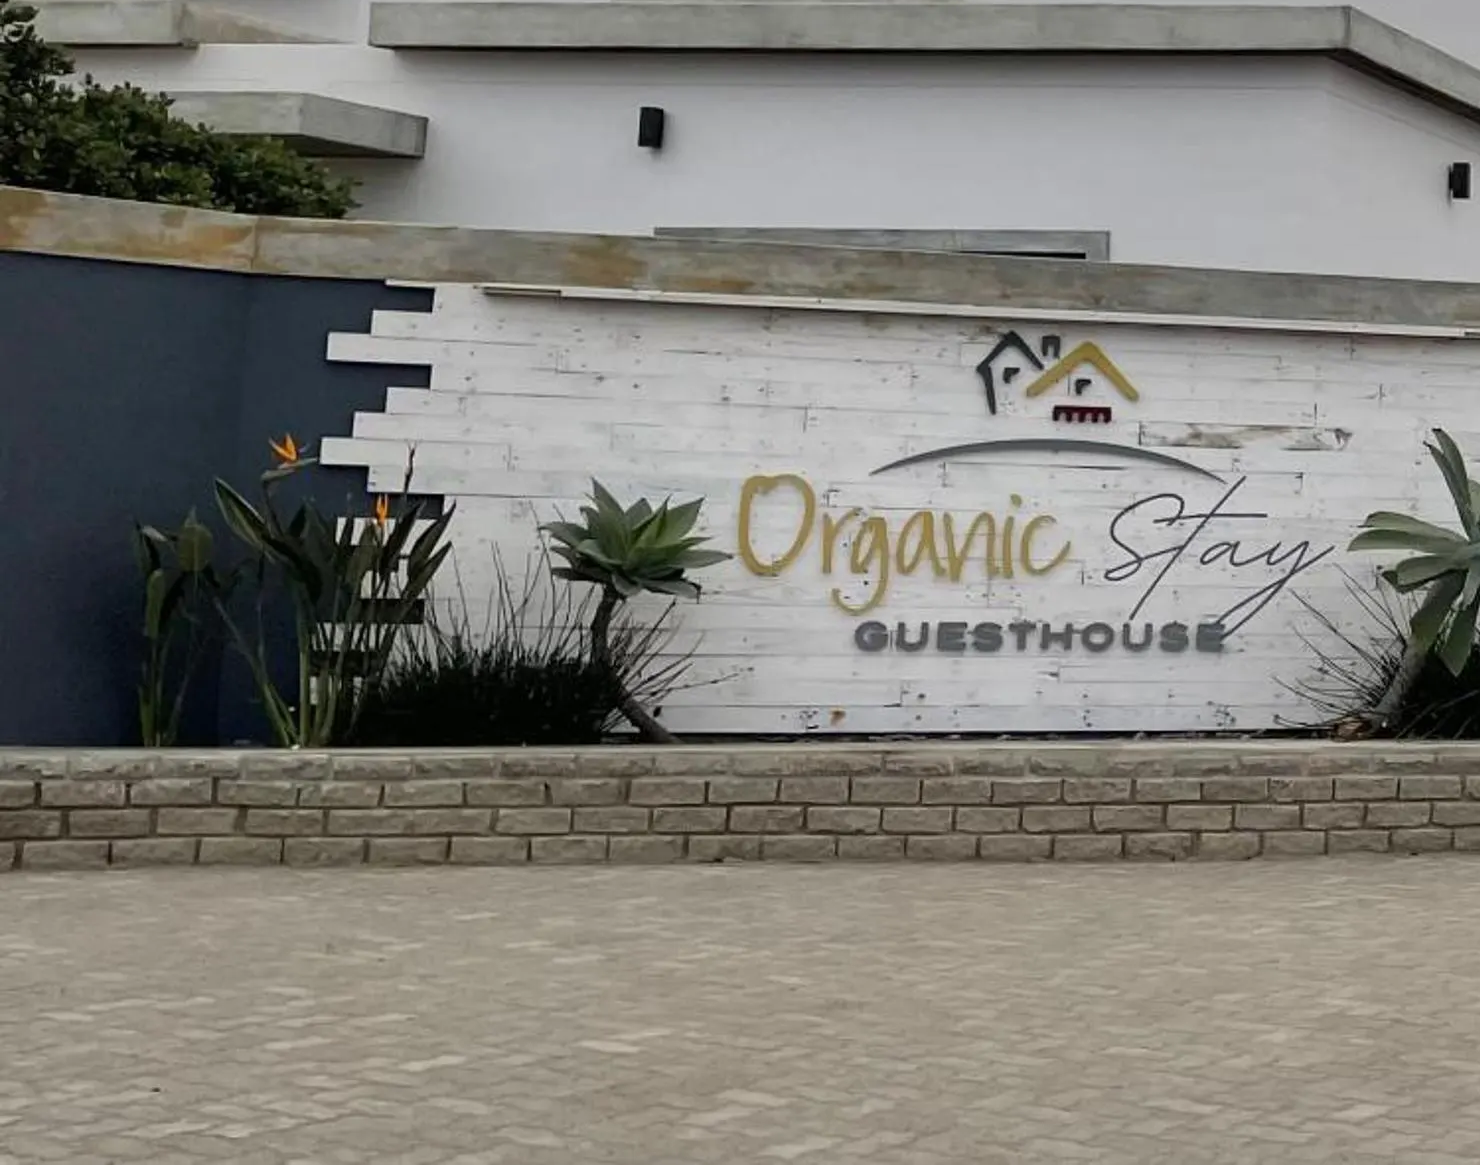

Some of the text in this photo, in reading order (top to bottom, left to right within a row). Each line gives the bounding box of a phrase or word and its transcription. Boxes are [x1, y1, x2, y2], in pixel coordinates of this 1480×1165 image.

[737, 473, 1335, 637] Organic Stay
[854, 620, 1226, 653] GUESTHOUSE
